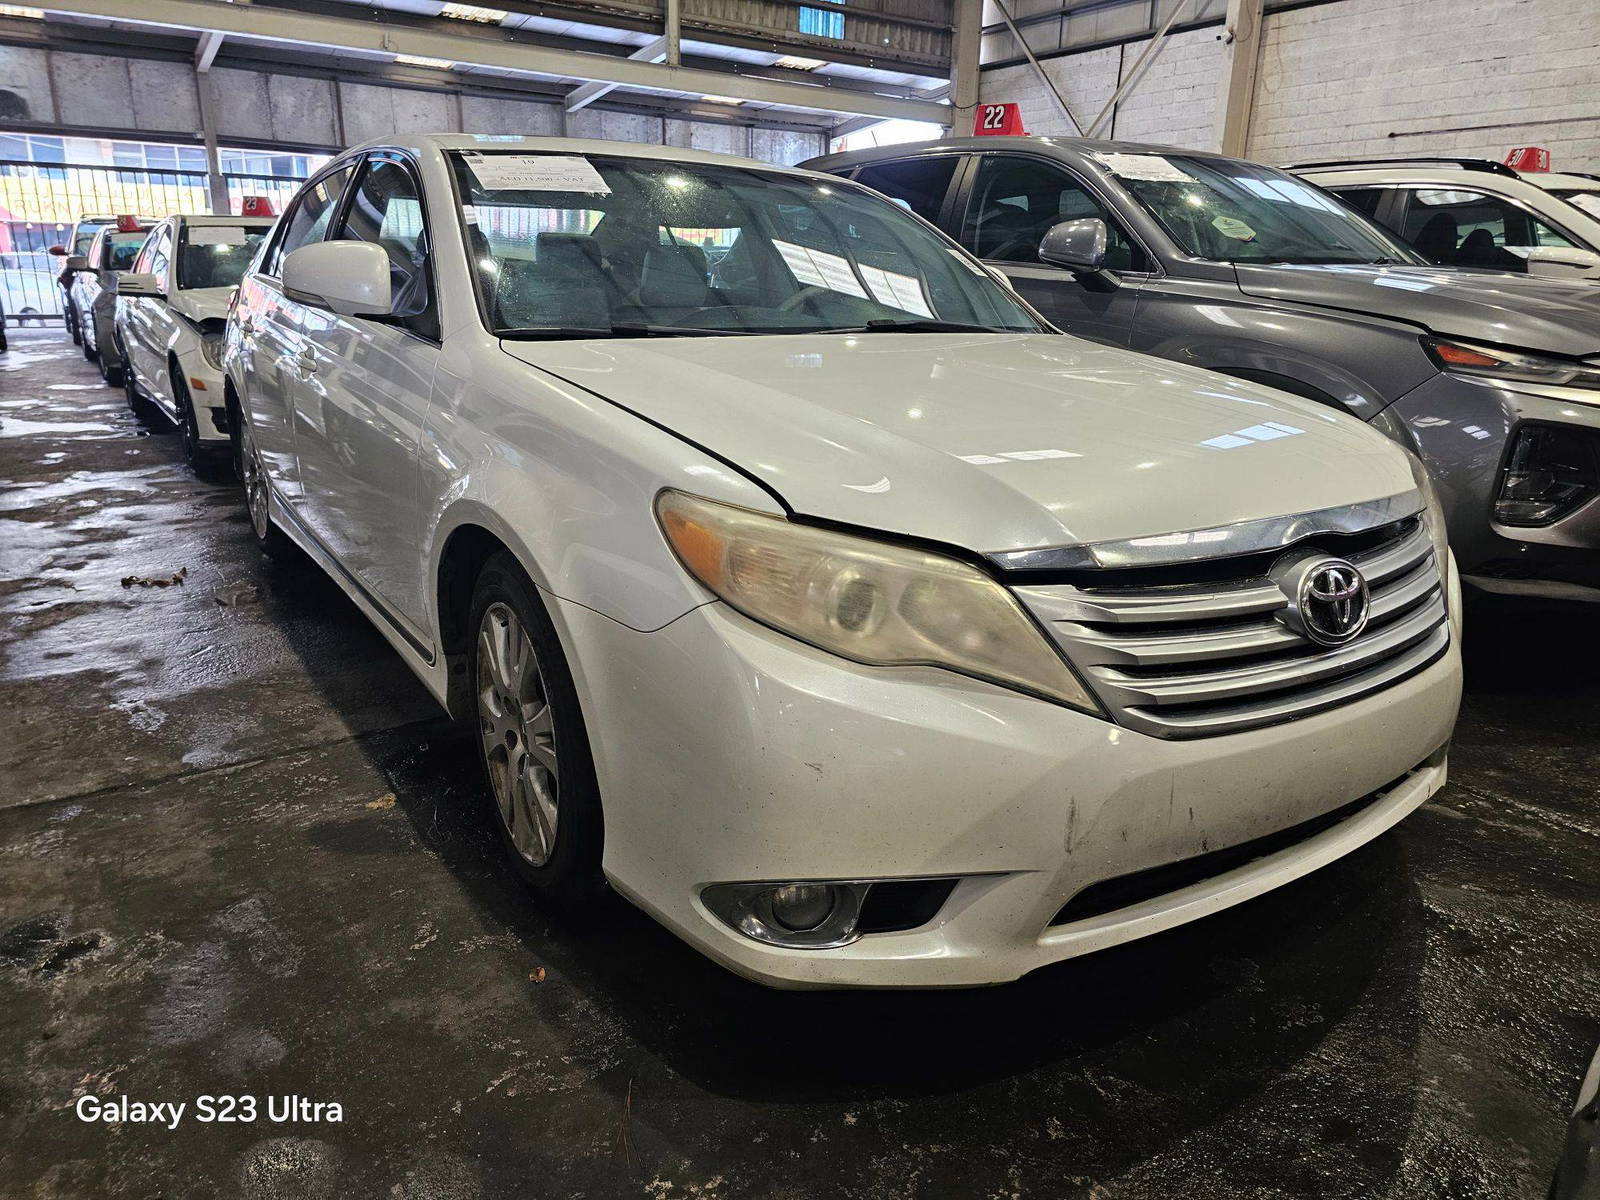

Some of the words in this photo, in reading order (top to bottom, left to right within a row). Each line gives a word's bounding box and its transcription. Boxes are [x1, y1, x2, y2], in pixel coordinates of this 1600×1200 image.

[983, 105, 1005, 129] 22
[1508, 149, 1526, 166] 30
[246, 197, 257, 210] 23
